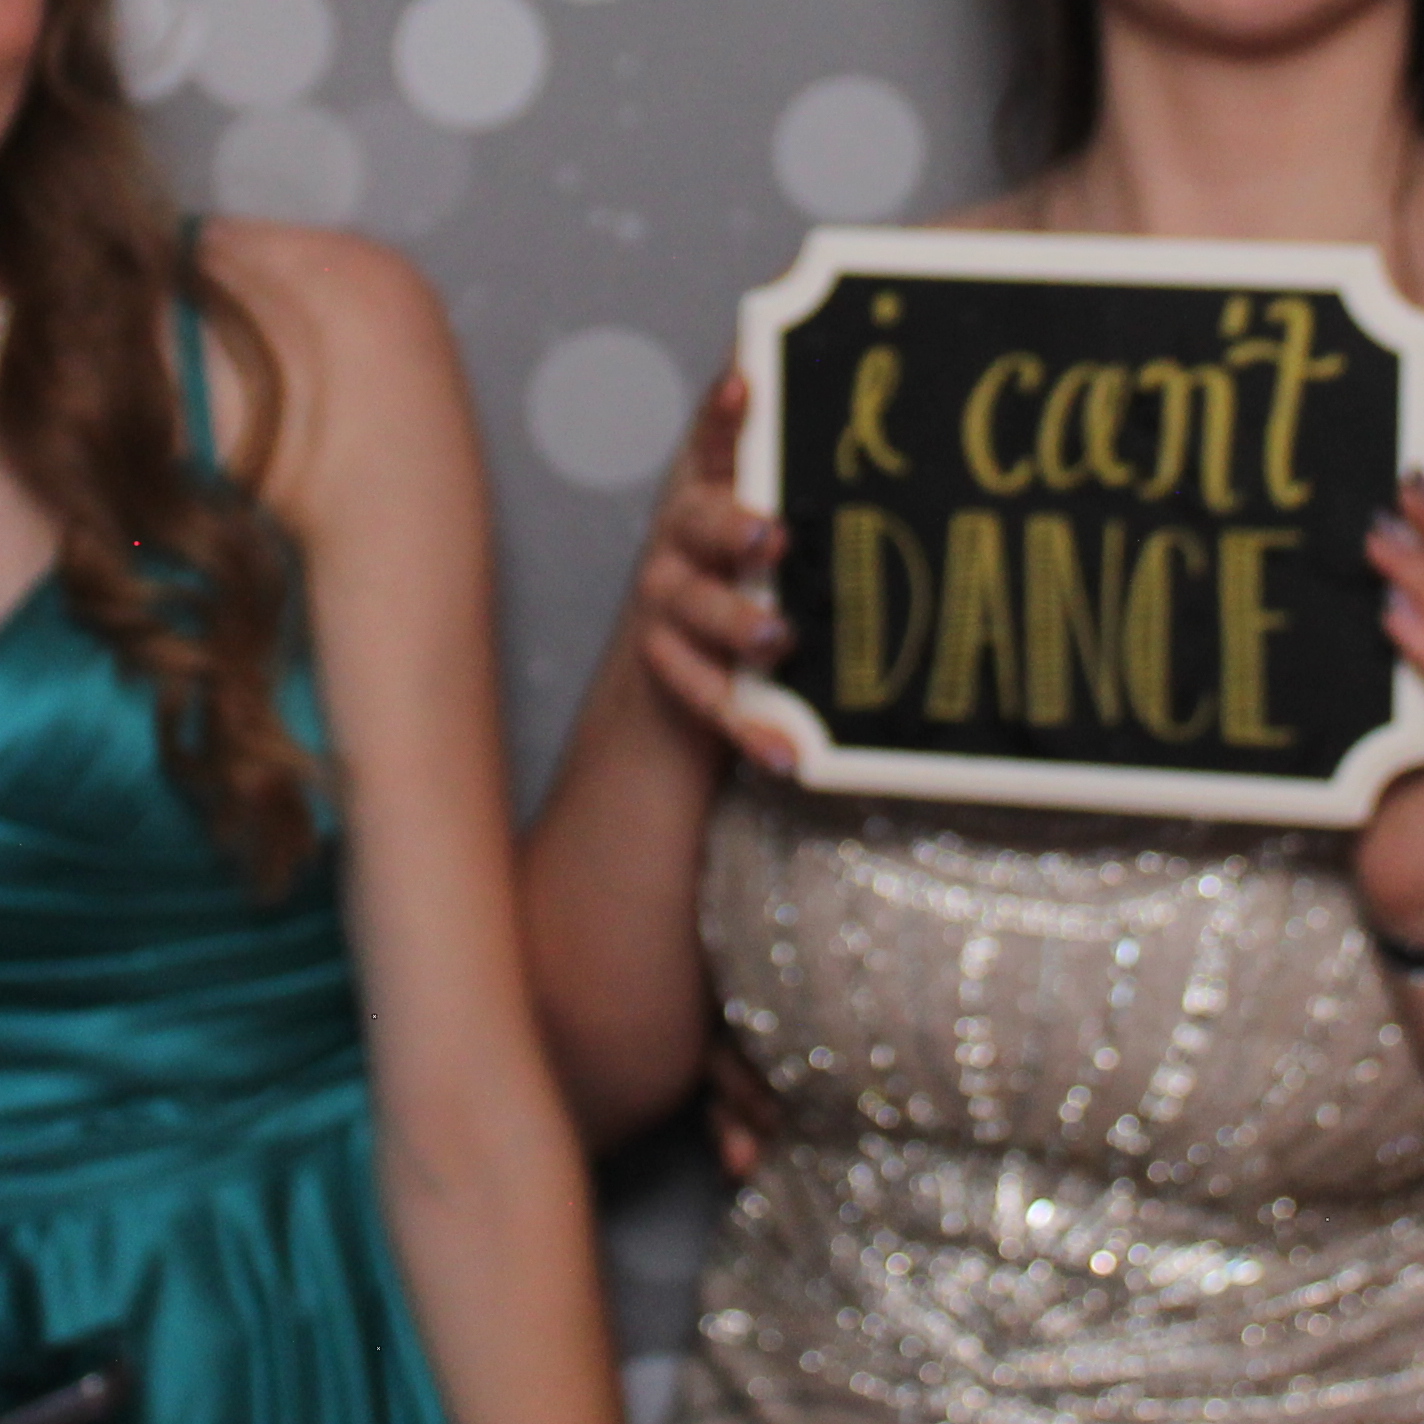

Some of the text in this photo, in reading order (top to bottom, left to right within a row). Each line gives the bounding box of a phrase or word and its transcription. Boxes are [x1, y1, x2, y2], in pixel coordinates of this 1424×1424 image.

[833, 290, 1346, 514] i can't
[832, 505, 1306, 748] DANCE
